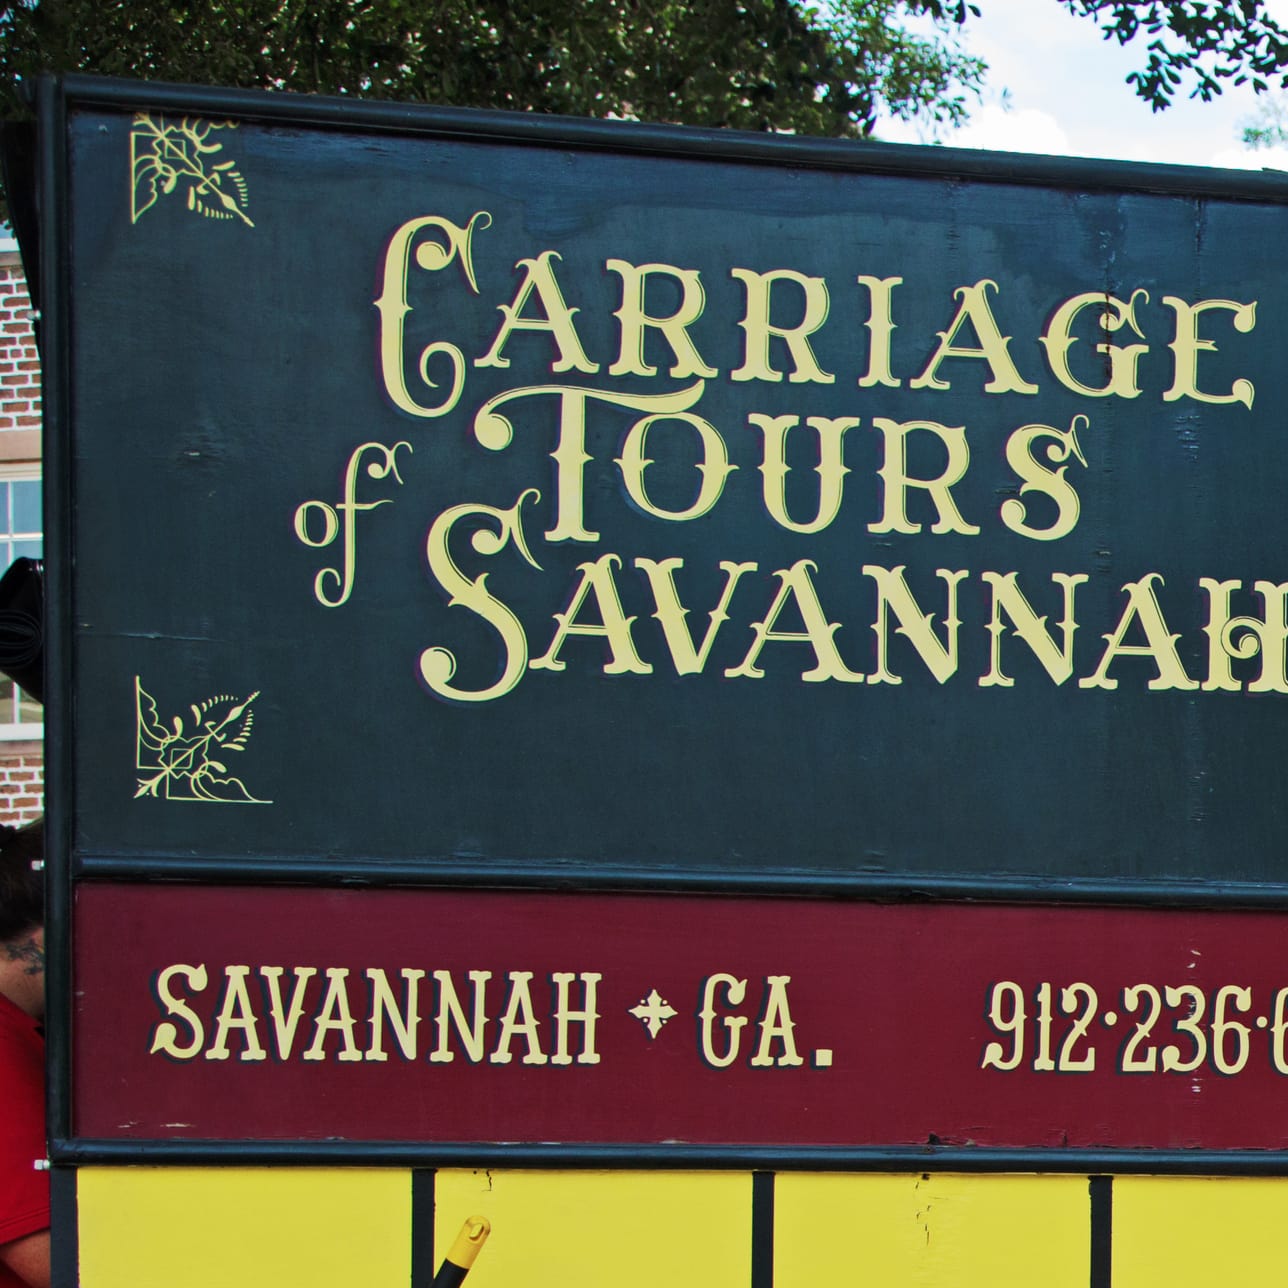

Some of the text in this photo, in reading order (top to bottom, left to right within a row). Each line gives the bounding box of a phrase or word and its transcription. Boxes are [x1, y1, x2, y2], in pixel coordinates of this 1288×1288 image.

[372, 210, 1259, 419] CARRIAGE
[293, 440, 413, 608] of
[473, 378, 1091, 545] TOURS
[150, 963, 833, 1069] SAVANNAH GA.
